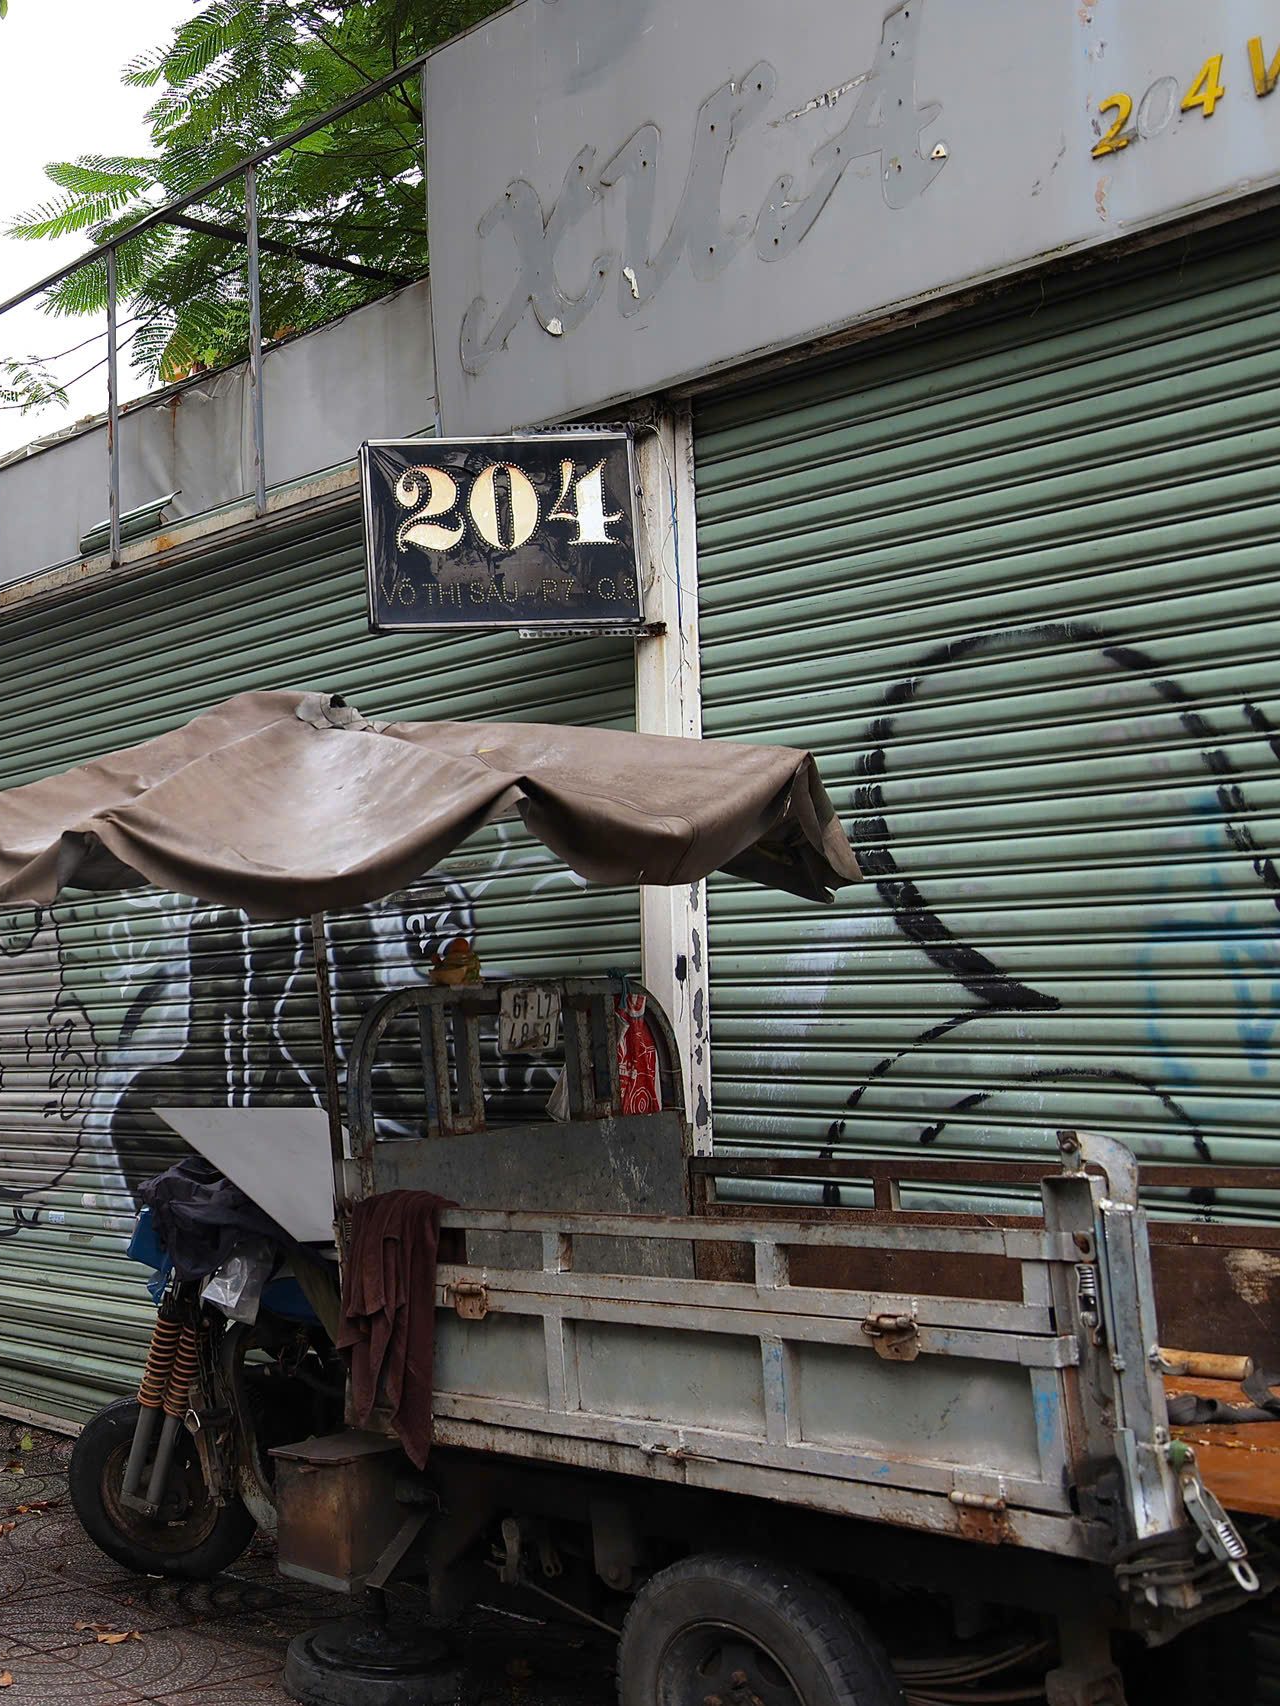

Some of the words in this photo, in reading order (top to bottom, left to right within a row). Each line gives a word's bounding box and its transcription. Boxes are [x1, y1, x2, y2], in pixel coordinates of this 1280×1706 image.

[1091, 53, 1225, 160] 204
[394, 458, 624, 553] 204
[380, 577, 417, 606] VÕ
[422, 582, 462, 609] THỊ
[470, 575, 518, 605] SÁU
